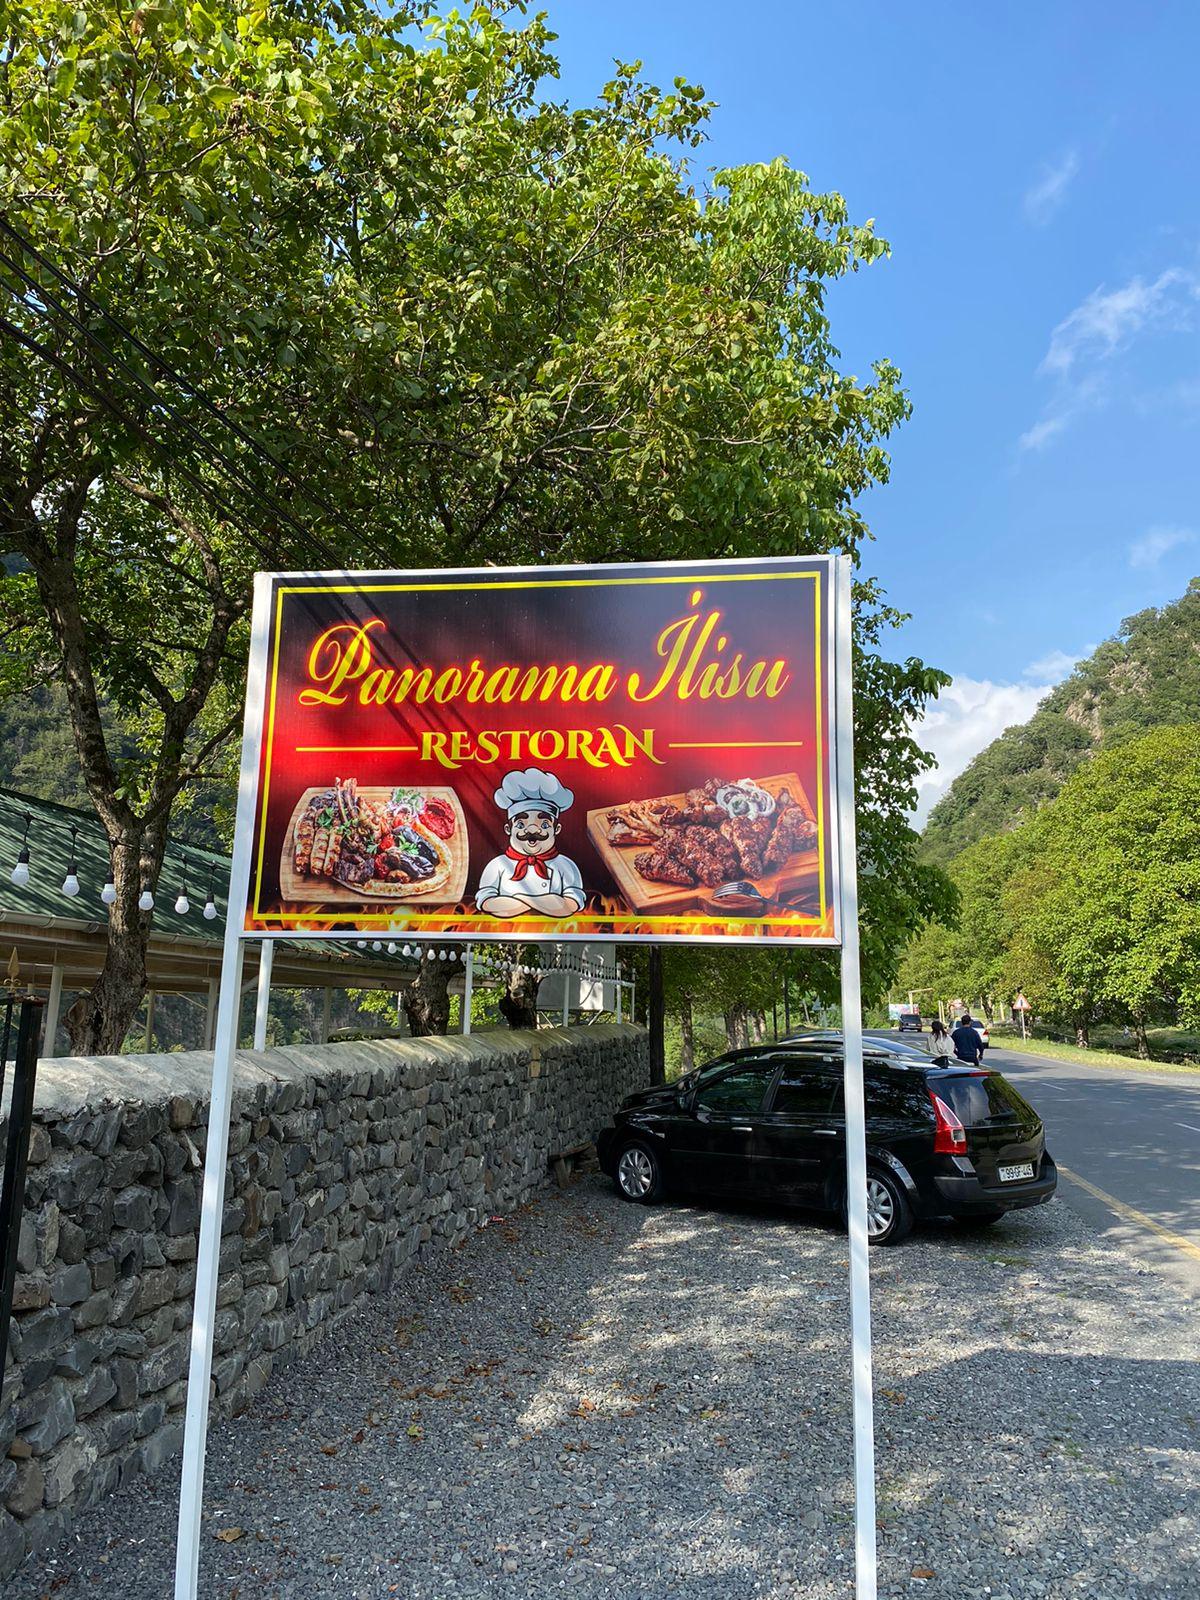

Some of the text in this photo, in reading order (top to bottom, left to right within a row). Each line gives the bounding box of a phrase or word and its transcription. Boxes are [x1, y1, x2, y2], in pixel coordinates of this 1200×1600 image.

[299, 590, 790, 706] Panorama İlisu
[420, 723, 667, 769] RESTORAN
